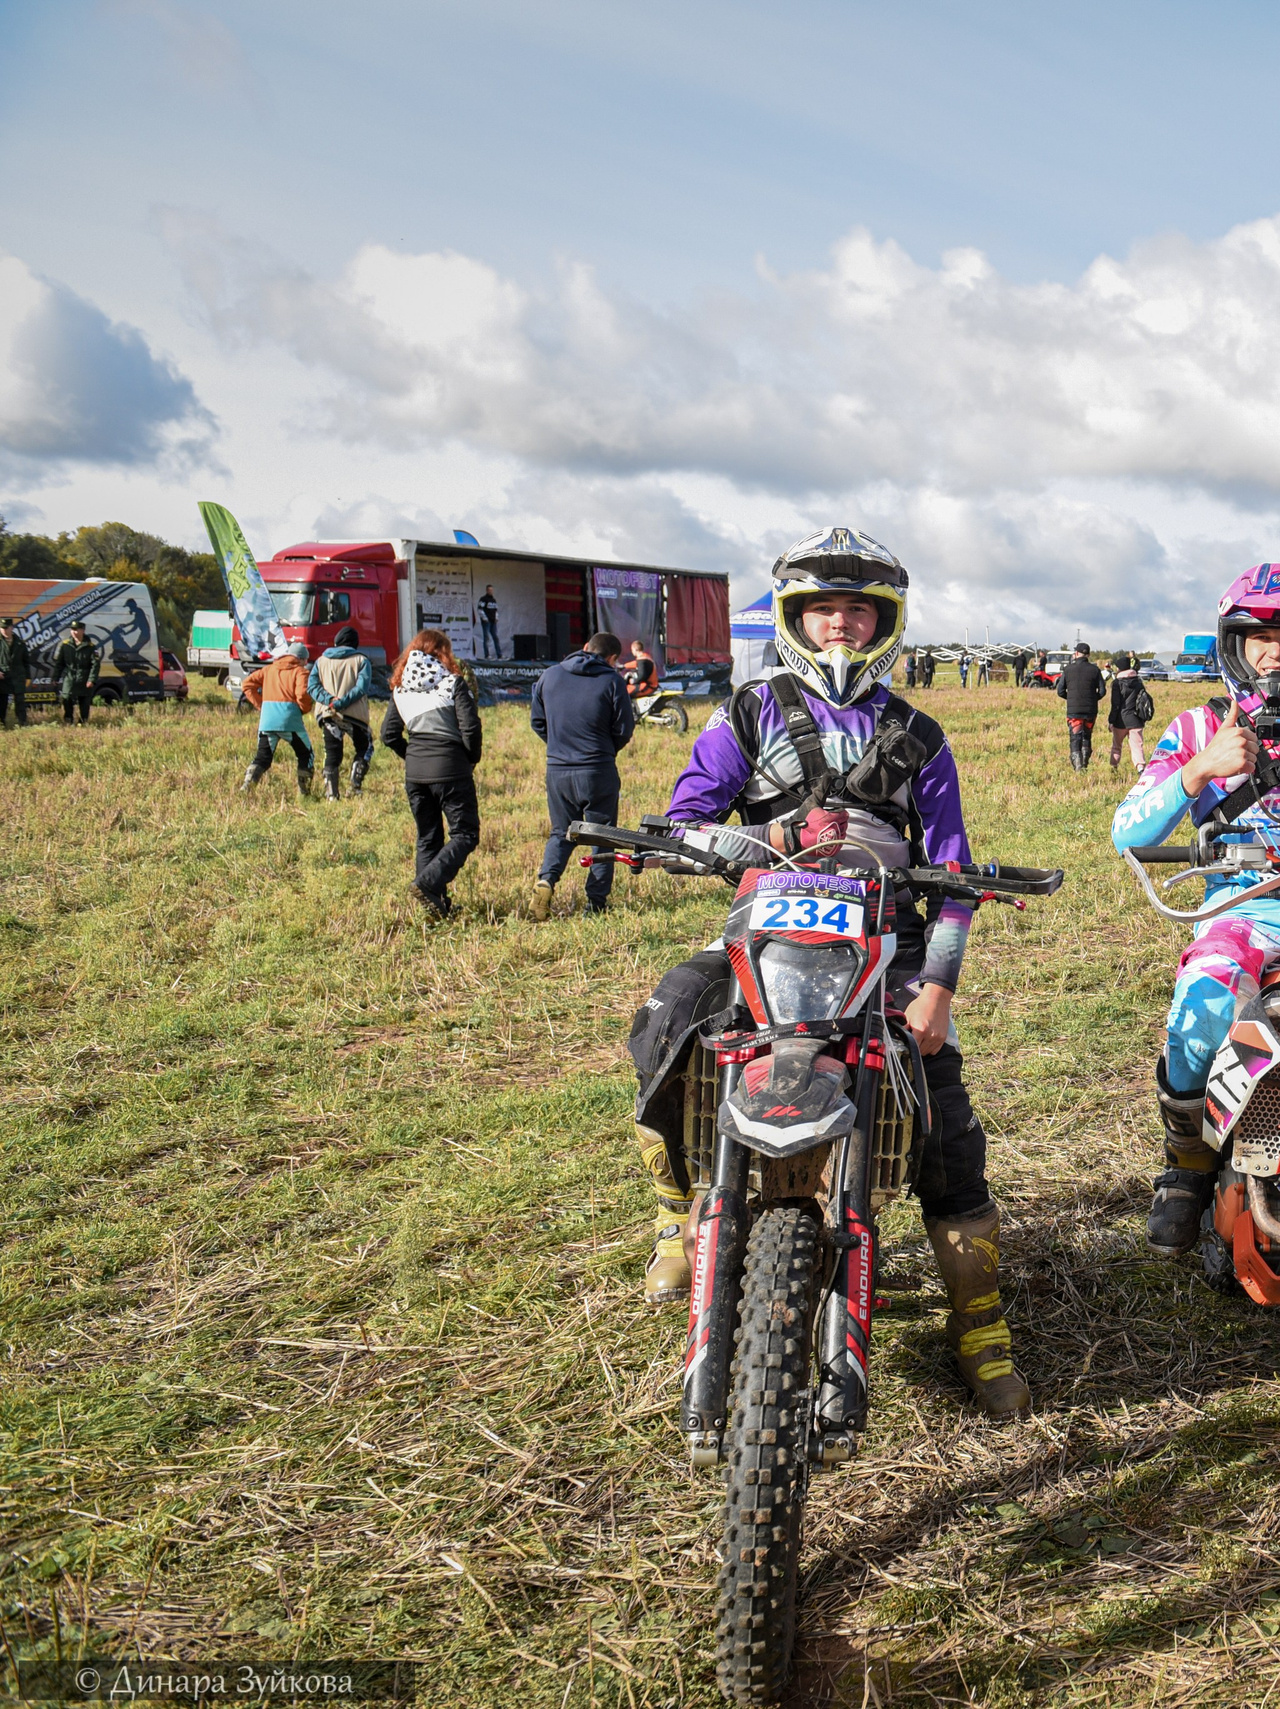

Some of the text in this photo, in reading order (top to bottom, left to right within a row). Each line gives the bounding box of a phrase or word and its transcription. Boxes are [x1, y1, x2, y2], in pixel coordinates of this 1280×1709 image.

[596, 567, 658, 590] MOTOFEST
[55, 589, 102, 621] МОТОШКОЛА
[1112, 789, 1166, 834] FXR
[757, 871, 862, 896] MOTOFEST
[761, 898, 850, 934] 234
[691, 1220, 709, 1317] ENDURO
[858, 1230, 870, 1321] ENDURO
